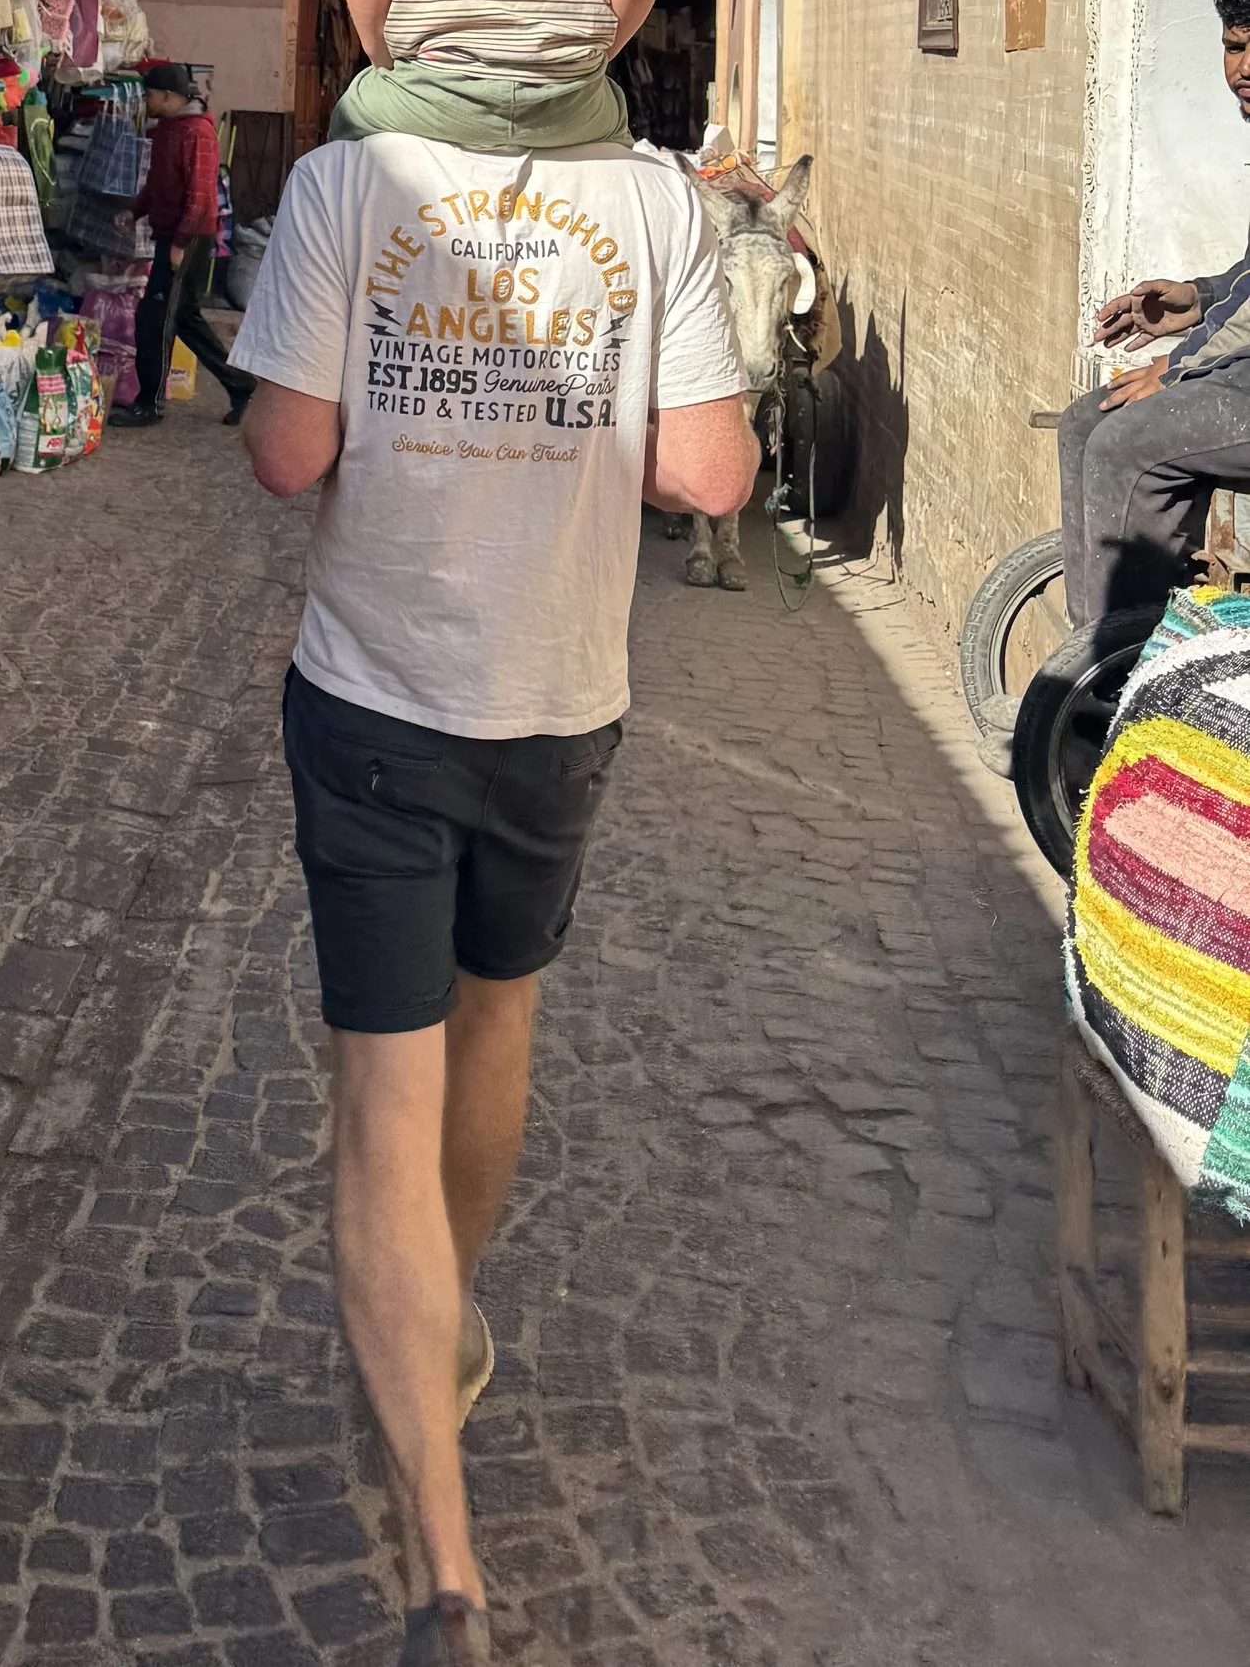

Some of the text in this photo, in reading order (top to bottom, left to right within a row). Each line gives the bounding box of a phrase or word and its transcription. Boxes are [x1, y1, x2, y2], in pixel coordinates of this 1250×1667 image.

[366, 186, 638, 313] THE STRONGHOLD
[451, 238, 560, 262] CALIFORNIA
[467, 267, 541, 305] LOS
[405, 302, 597, 347] ANGELES
[369, 338, 621, 373] VINTAGE MOTORCYCLES
[483, 369, 560, 394] Genuine
[557, 374, 616, 397] Parts
[367, 390, 426, 416] TRIED
[436, 398, 453, 419] &
[461, 400, 537, 423] TESTED
[392, 433, 579, 462] Service You Can Trust
